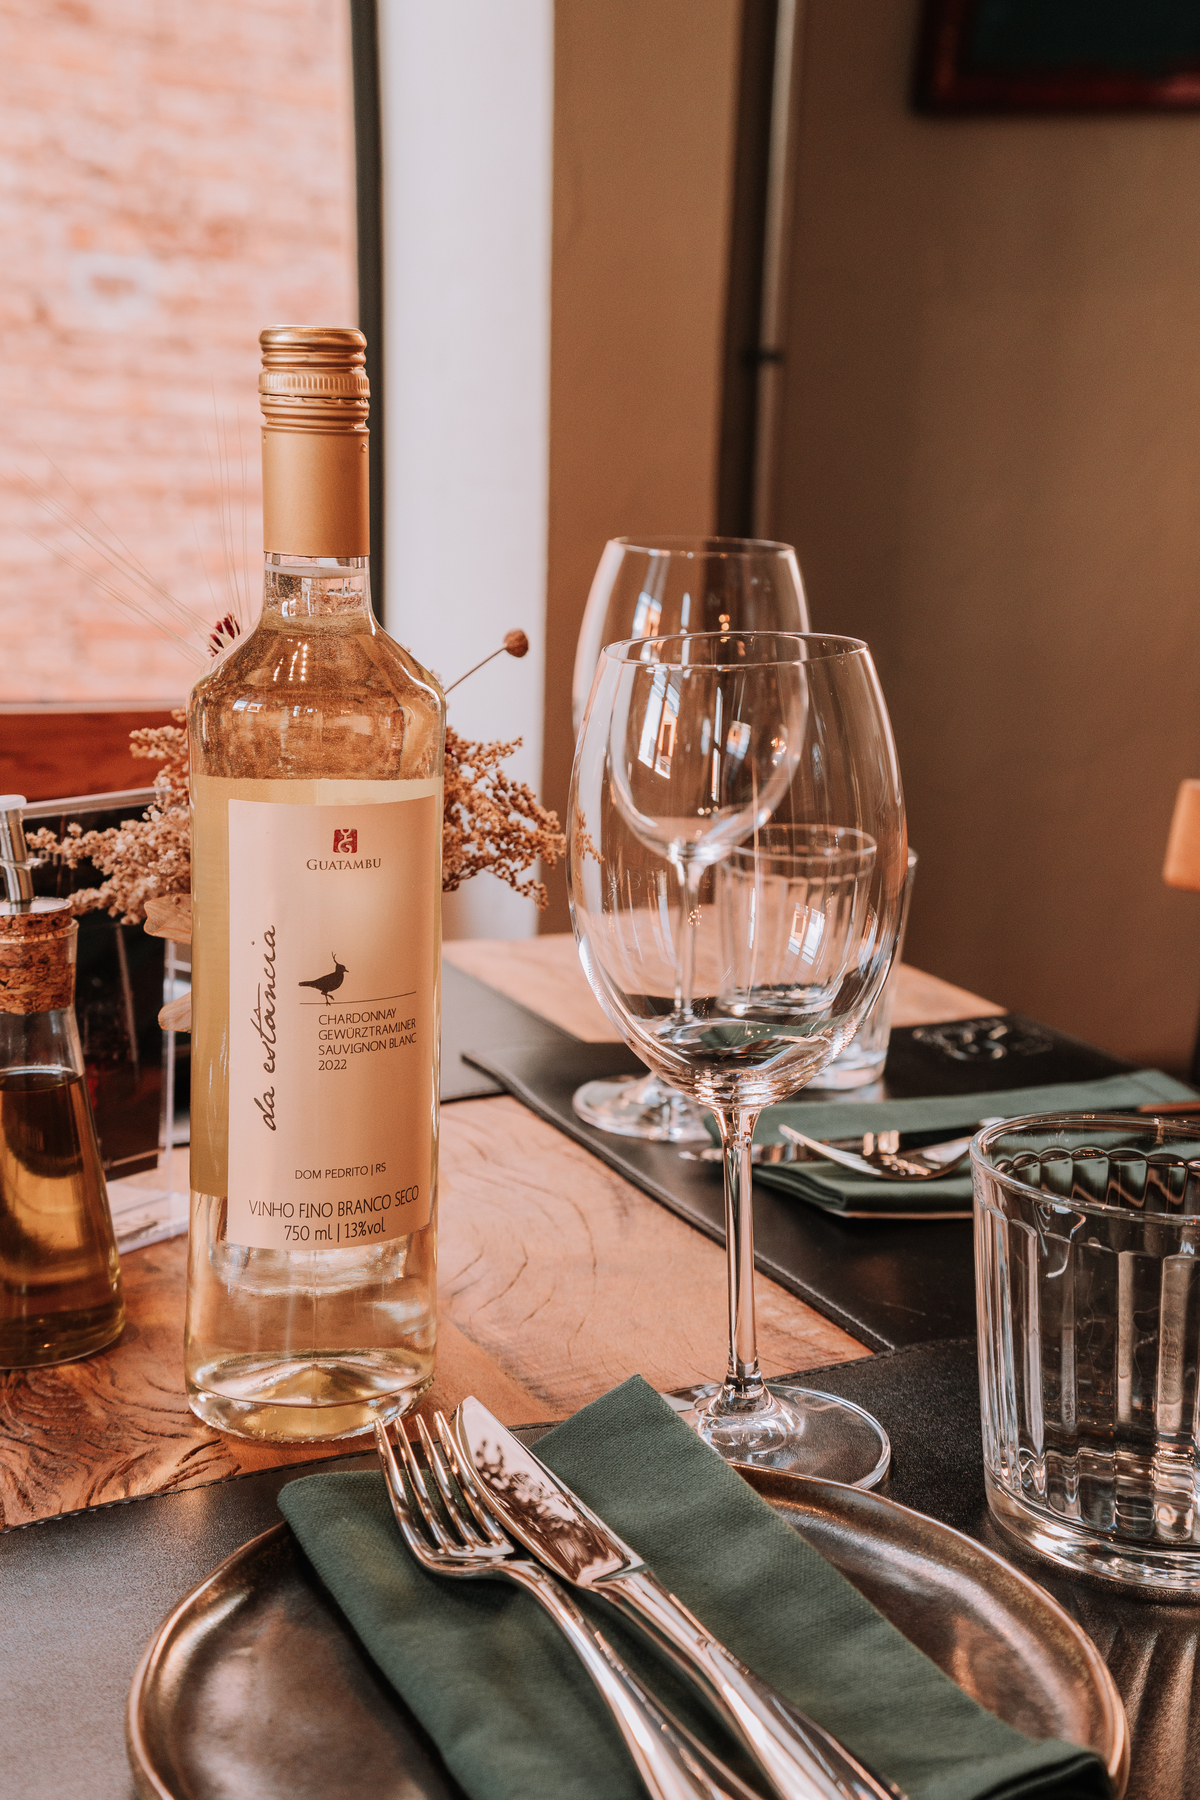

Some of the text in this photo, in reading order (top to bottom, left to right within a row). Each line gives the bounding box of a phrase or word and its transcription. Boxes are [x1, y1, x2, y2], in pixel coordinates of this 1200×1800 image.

[318, 1008, 397, 1025] CHARDONNAY
[318, 1018, 416, 1040] GEWÜRZTRAMINER
[318, 1032, 417, 1056] SAUVIGNON BLANC
[318, 1059, 347, 1071] 2022
[253, 1086, 277, 1131] da
[295, 1169, 322, 1180] DOM
[325, 1165, 369, 1179] PEDRITO
[375, 1162, 387, 1173] RS
[248, 1185, 419, 1219] VINHO FINO BRANCO SECO
[284, 1225, 310, 1241] 750
[314, 1224, 333, 1241] ml
[344, 1217, 386, 1239] 13%vol
